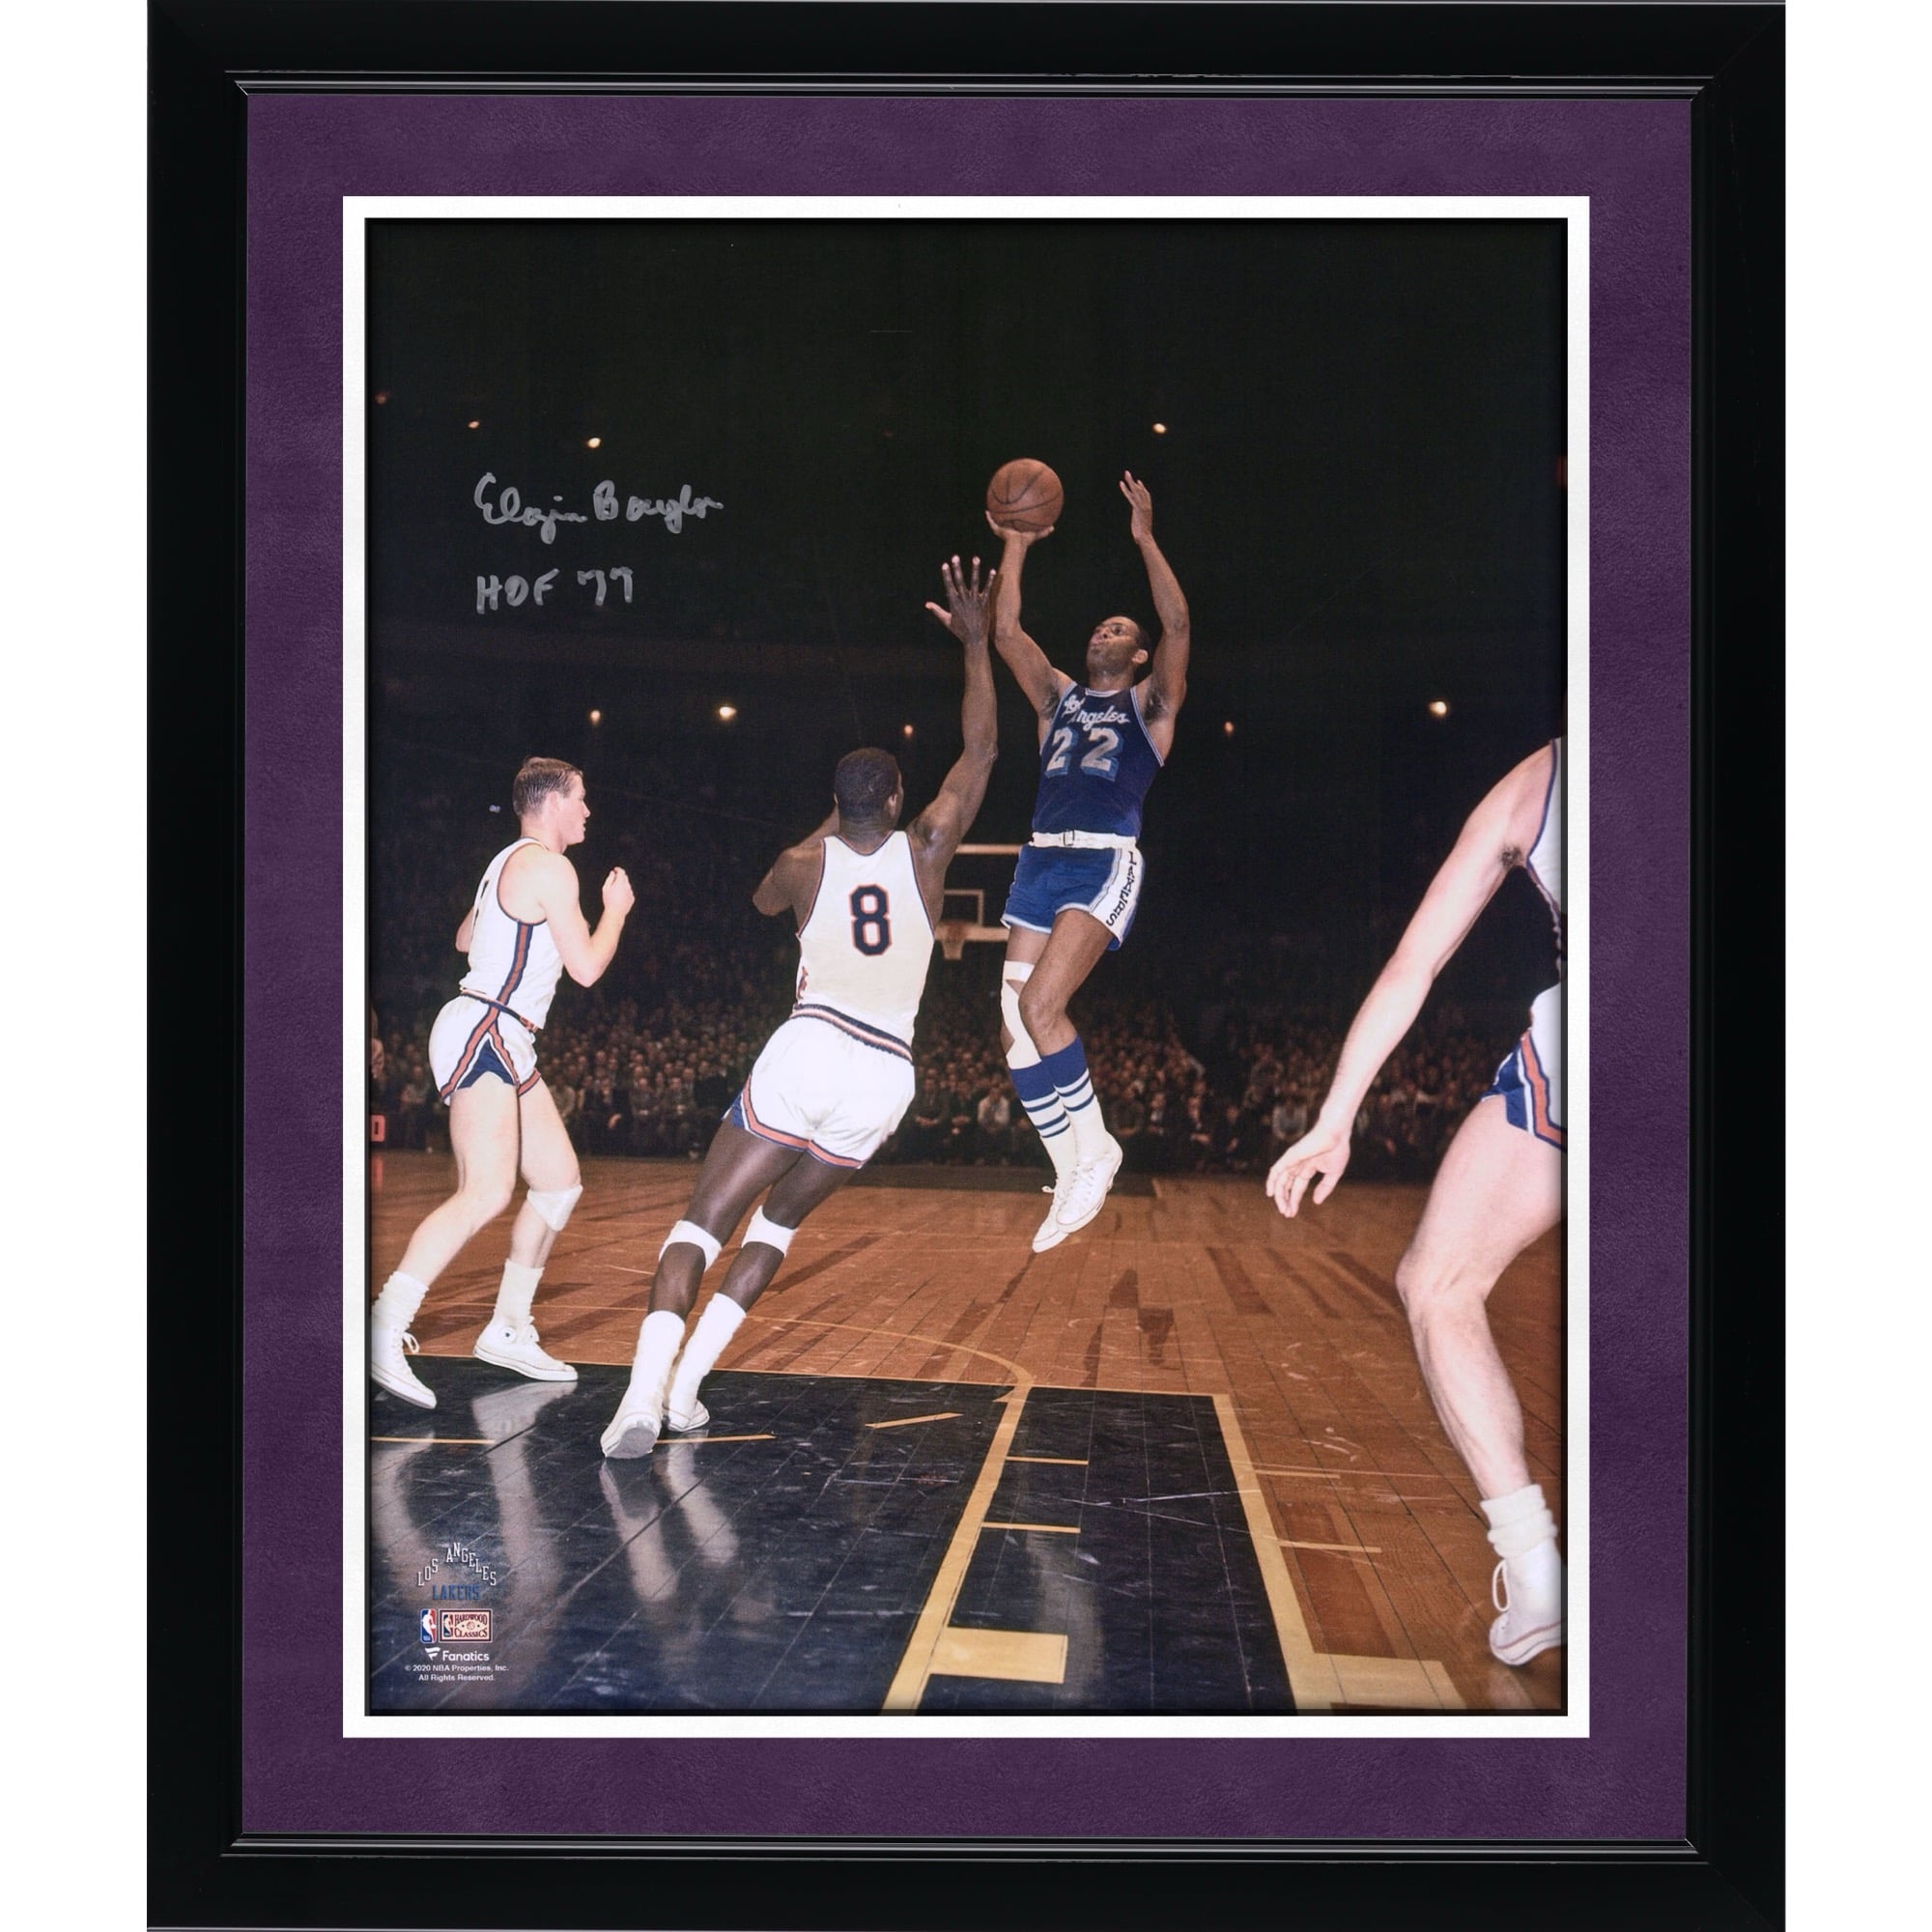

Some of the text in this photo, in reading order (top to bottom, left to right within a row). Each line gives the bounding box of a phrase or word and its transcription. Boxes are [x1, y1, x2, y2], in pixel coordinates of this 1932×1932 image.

[476, 568, 560, 614] HOF
[1045, 725, 1124, 781] 22
[848, 883, 894, 957] 8
[1106, 850, 1137, 927] LAKERS
